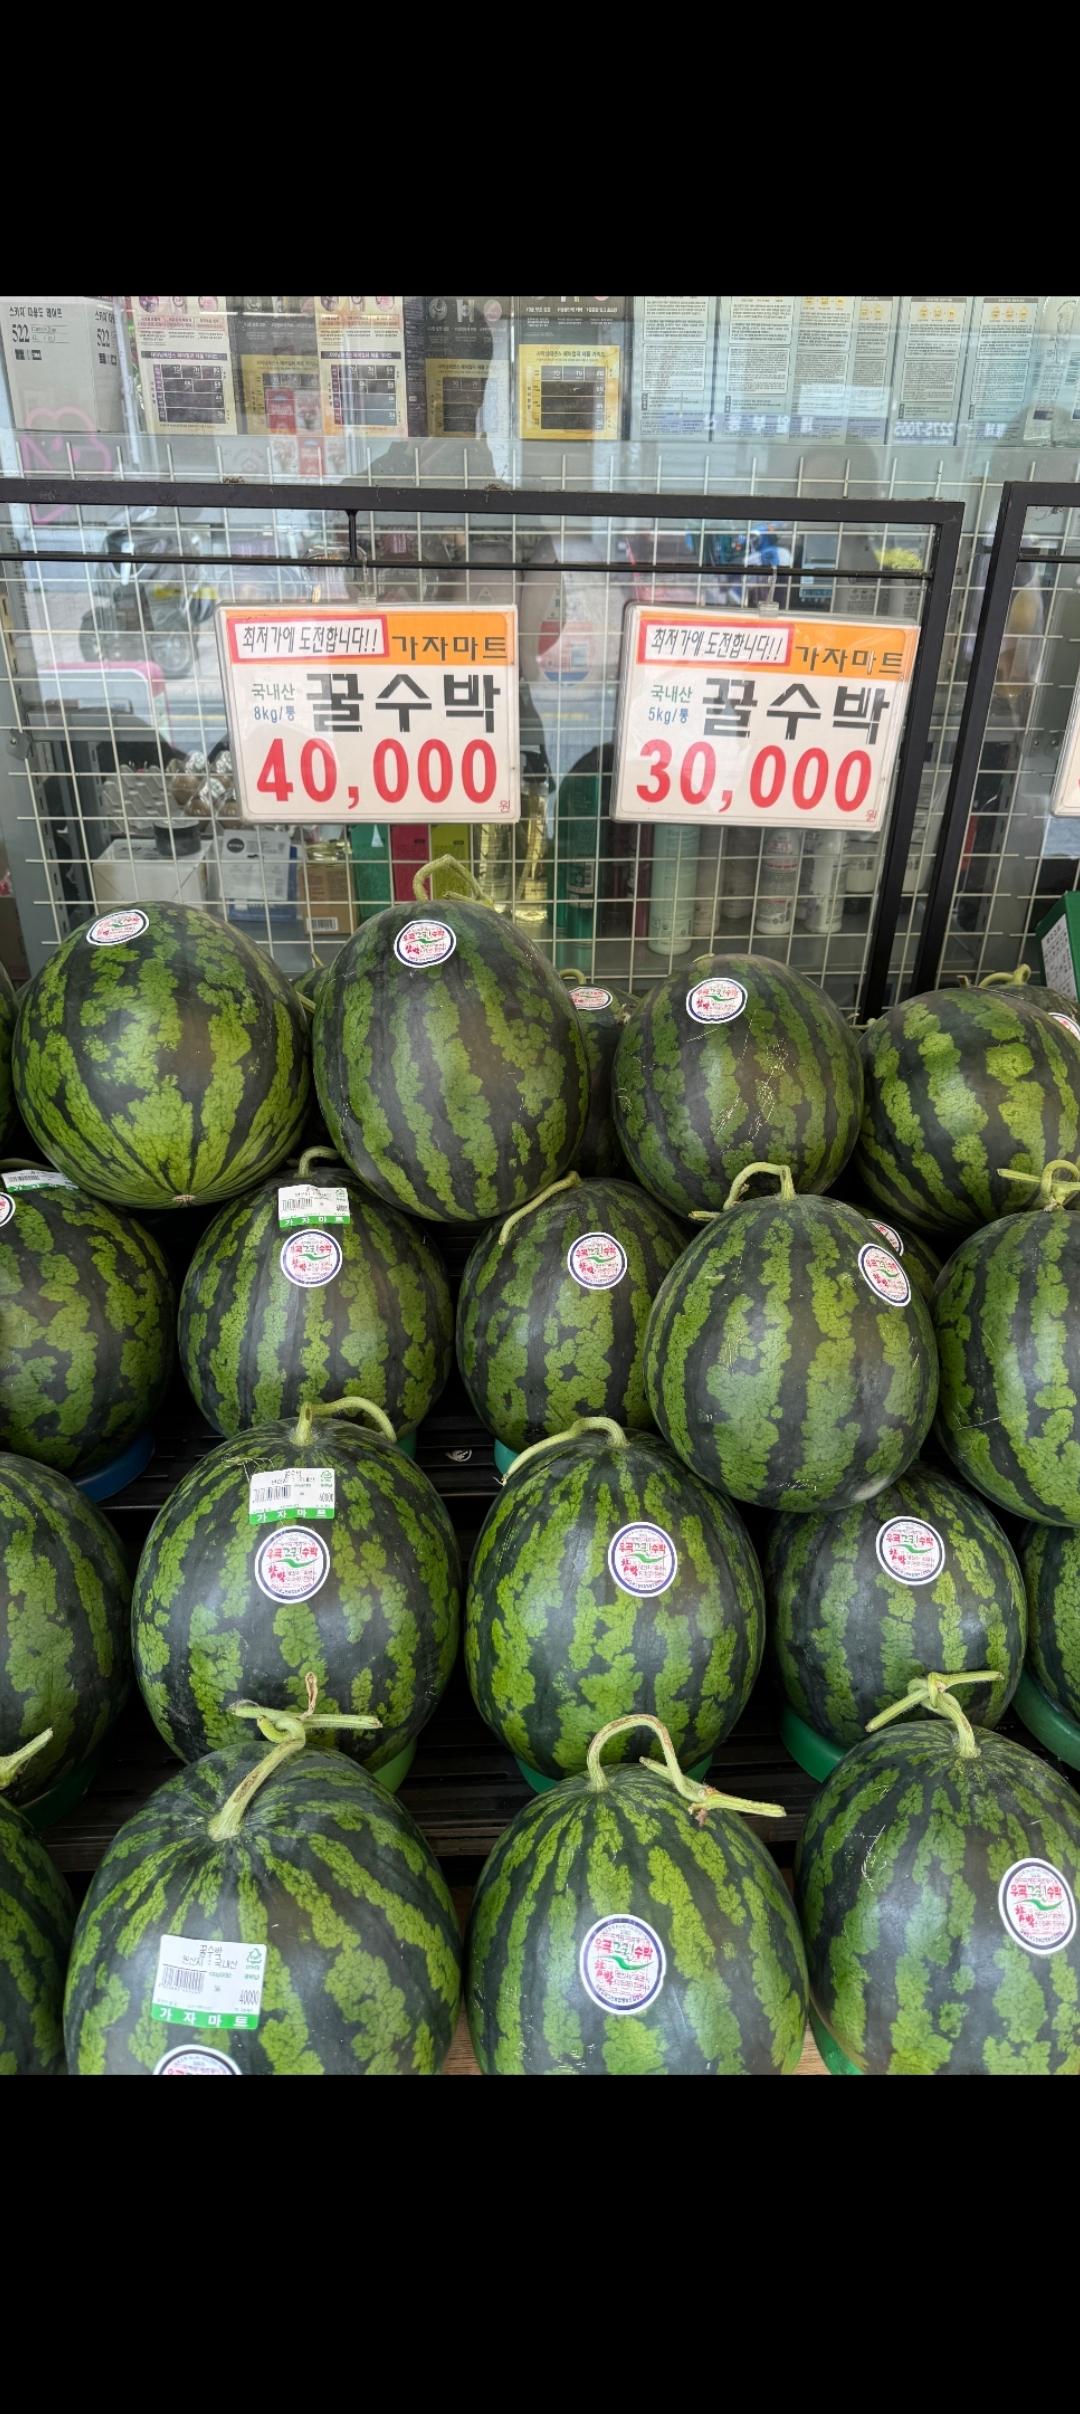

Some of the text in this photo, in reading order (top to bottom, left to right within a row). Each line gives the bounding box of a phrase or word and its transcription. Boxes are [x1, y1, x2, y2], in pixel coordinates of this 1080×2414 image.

[12, 324, 30, 343] 522
[243, 624, 378, 653] 최저가에 도전합니다!!
[392, 636, 507, 661] 가자마트
[651, 628, 782, 661] 최저가에 도전합니다!!
[795, 646, 903, 676] 가자마트
[251, 683, 296, 701] 국내산
[651, 684, 693, 703] 국내산
[307, 673, 501, 733] 꿀수박
[702, 677, 890, 745] 꿀수박
[254, 706, 296, 724] 8kg/통
[648, 707, 689, 725] 5kg/통
[256, 738, 497, 810] 40,000
[636, 739, 872, 813] 30,000
[500, 800, 511, 813] 원
[865, 809, 878, 823] 원
[256, 1509, 327, 1522] 가자마트
[160, 2007, 248, 2027] 가자마트
